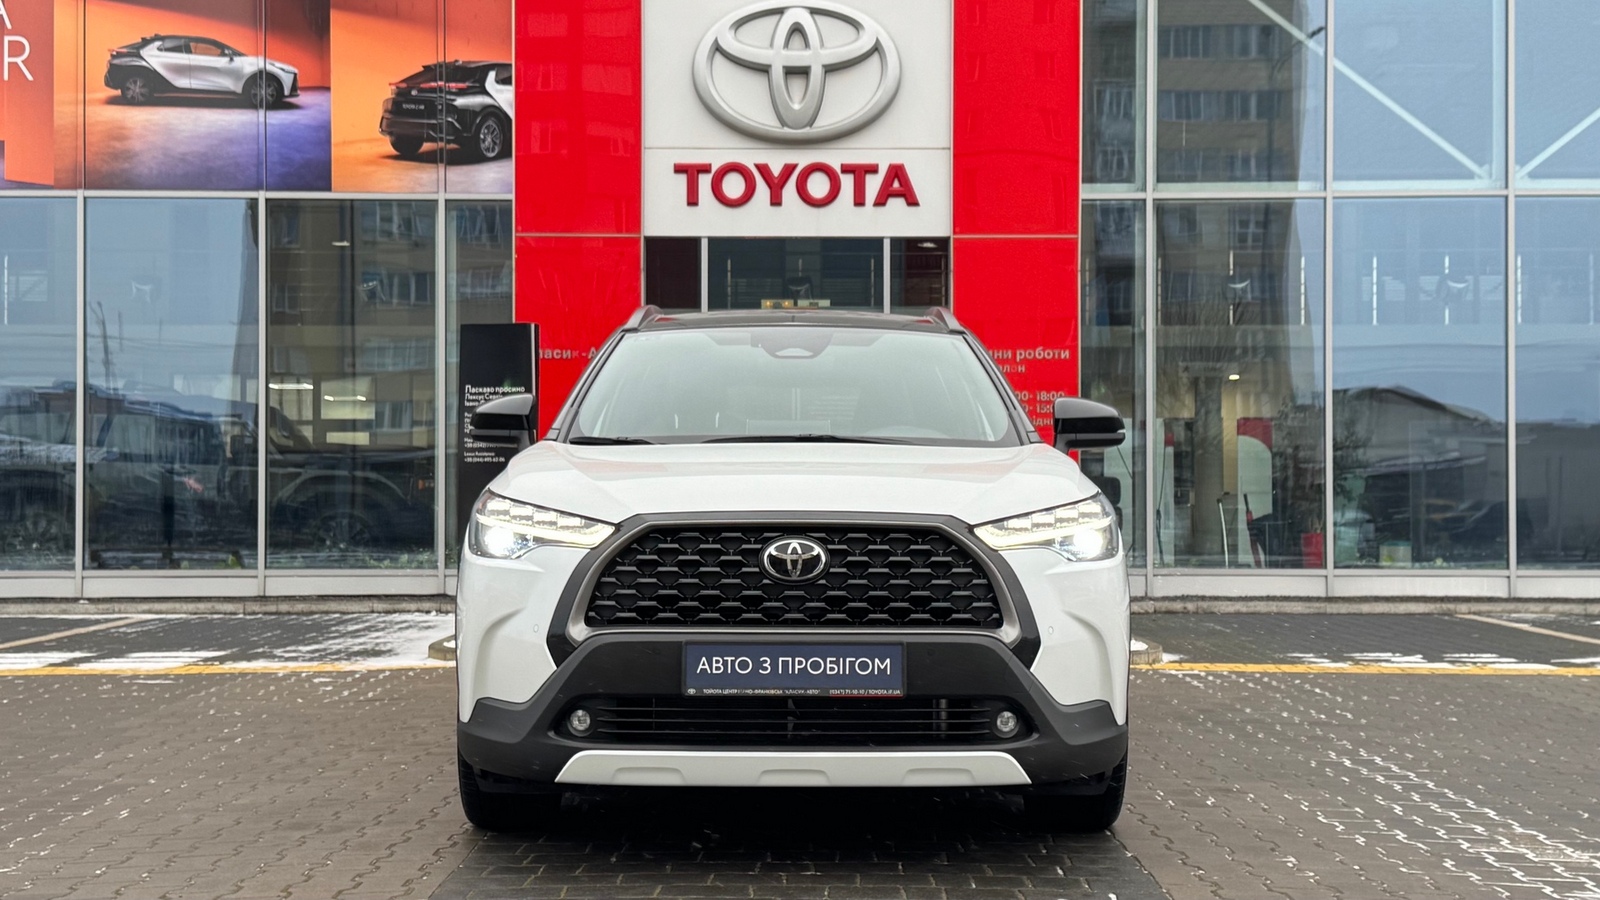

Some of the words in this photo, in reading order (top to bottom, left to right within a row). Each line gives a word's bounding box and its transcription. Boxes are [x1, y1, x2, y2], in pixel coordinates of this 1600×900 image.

[673, 162, 921, 208] TOYOTA
[540, 346, 597, 360] асик-А
[1016, 346, 1070, 363] роботи
[696, 656, 753, 675] АВТО
[758, 656, 772, 675] З
[778, 657, 891, 676] ПРОБІГОМ
